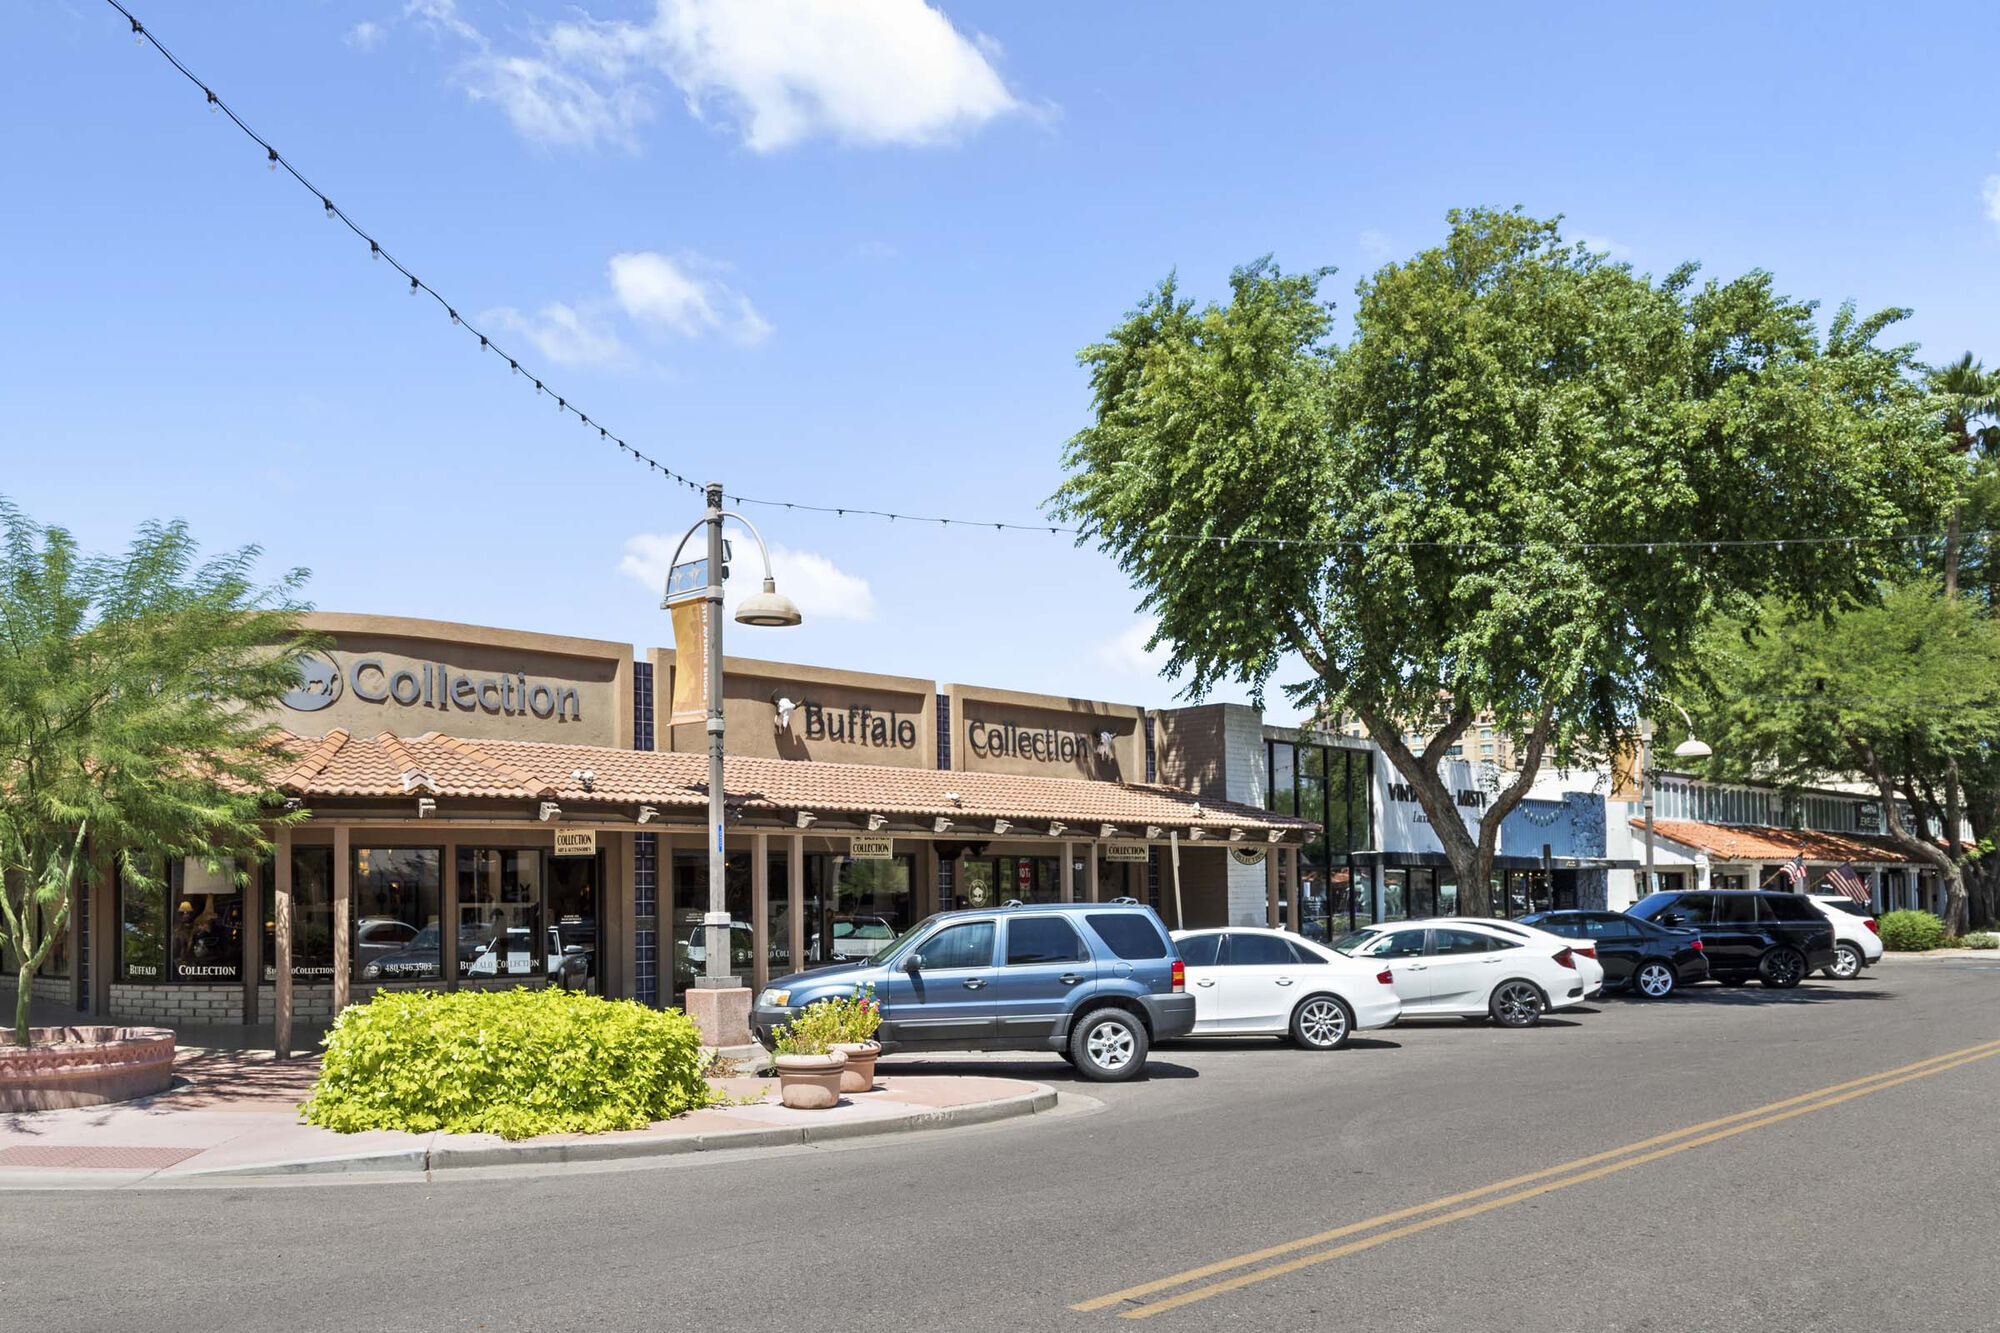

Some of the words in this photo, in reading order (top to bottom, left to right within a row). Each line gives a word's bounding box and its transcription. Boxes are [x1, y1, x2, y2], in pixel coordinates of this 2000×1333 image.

[351, 658, 580, 716] Collection
[804, 701, 916, 745] Buffalo
[969, 719, 1089, 759] Collection
[557, 834, 592, 846] COLLECTION
[853, 843, 889, 853] COLLECTION
[1108, 846, 1146, 856] COLLECTION
[129, 964, 157, 976] BUFFALO
[178, 964, 236, 976] COLLECTION
